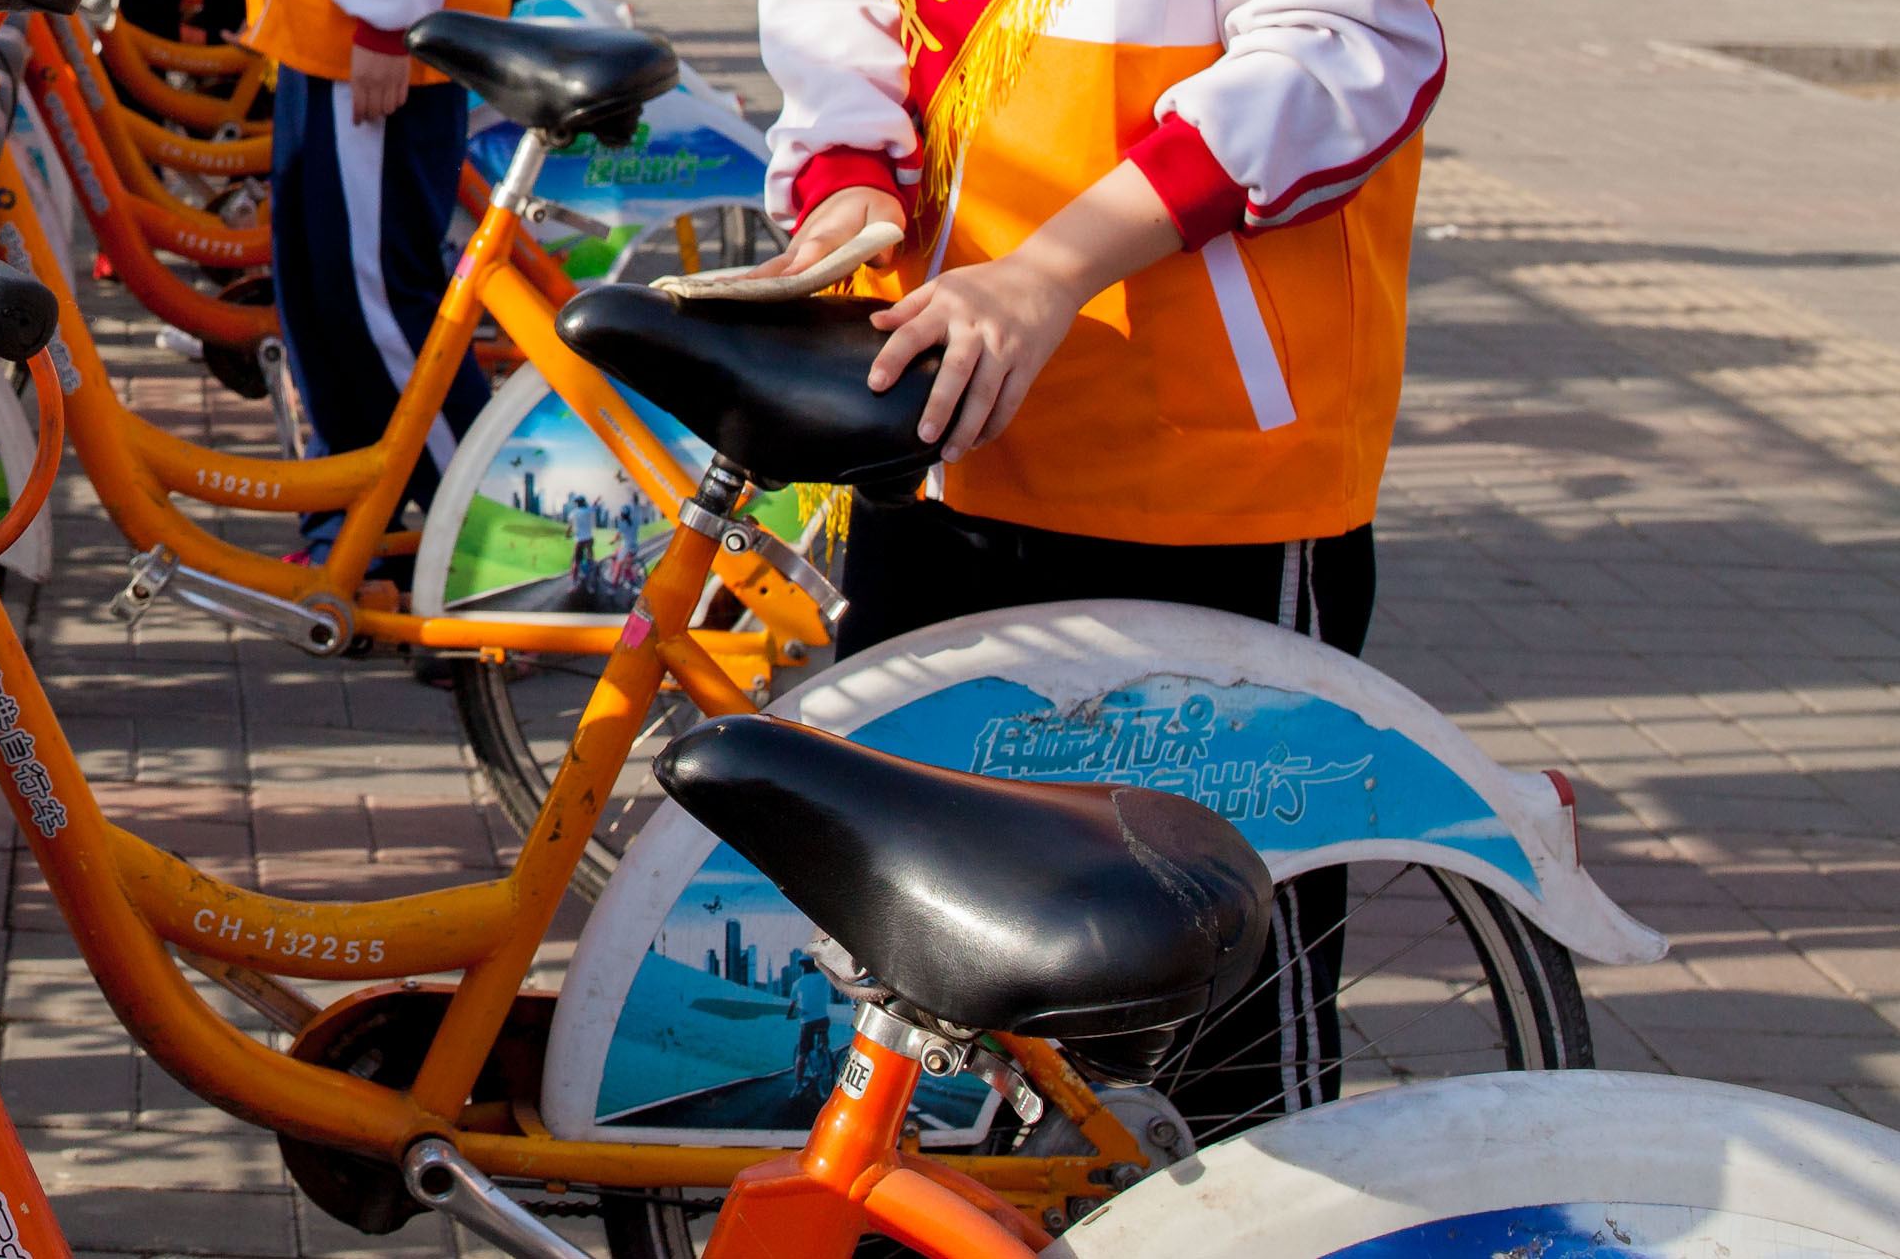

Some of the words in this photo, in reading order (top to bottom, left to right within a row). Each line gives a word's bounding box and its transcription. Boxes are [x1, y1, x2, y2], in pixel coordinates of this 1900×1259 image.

[1094, 741, 1374, 825] 色出行
[192, 907, 385, 964] CH-132255
